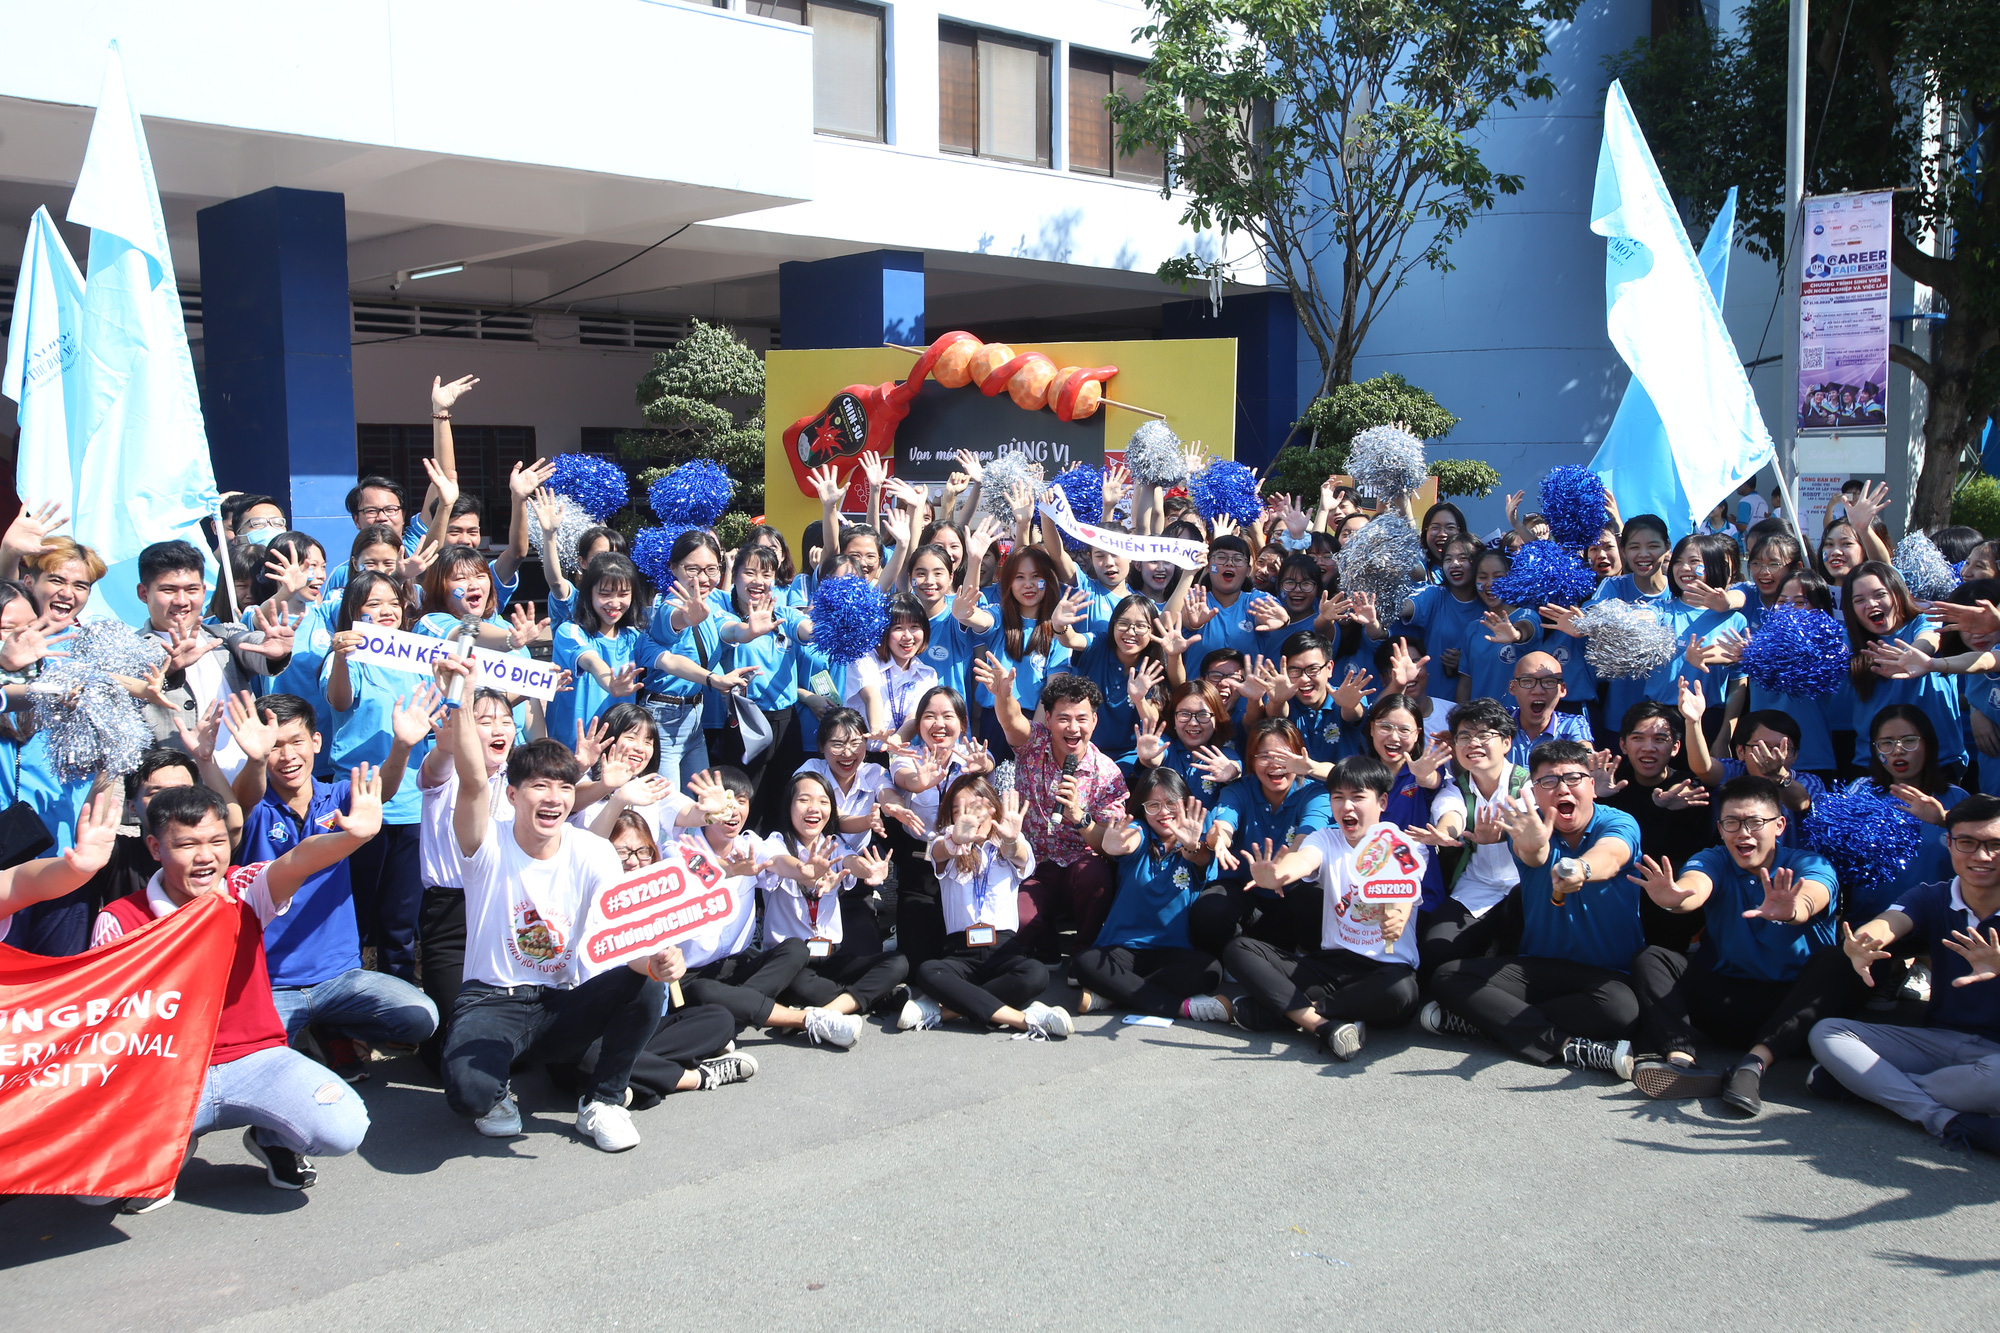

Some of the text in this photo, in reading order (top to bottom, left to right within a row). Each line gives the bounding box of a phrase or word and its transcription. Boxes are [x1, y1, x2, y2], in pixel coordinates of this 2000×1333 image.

[1833, 265, 1857, 274] FAIR
[1859, 263, 1886, 271] 2020
[842, 397, 864, 440] CHIN-SU
[908, 446, 932, 466] Vạn
[1051, 441, 1070, 466] VỊ
[1099, 535, 1145, 553] CHIẾN
[482, 659, 507, 679] VÔ
[510, 666, 553, 689] ĐỊCH
[606, 872, 680, 914] #SV2020
[1366, 883, 1413, 895] #SV2020
